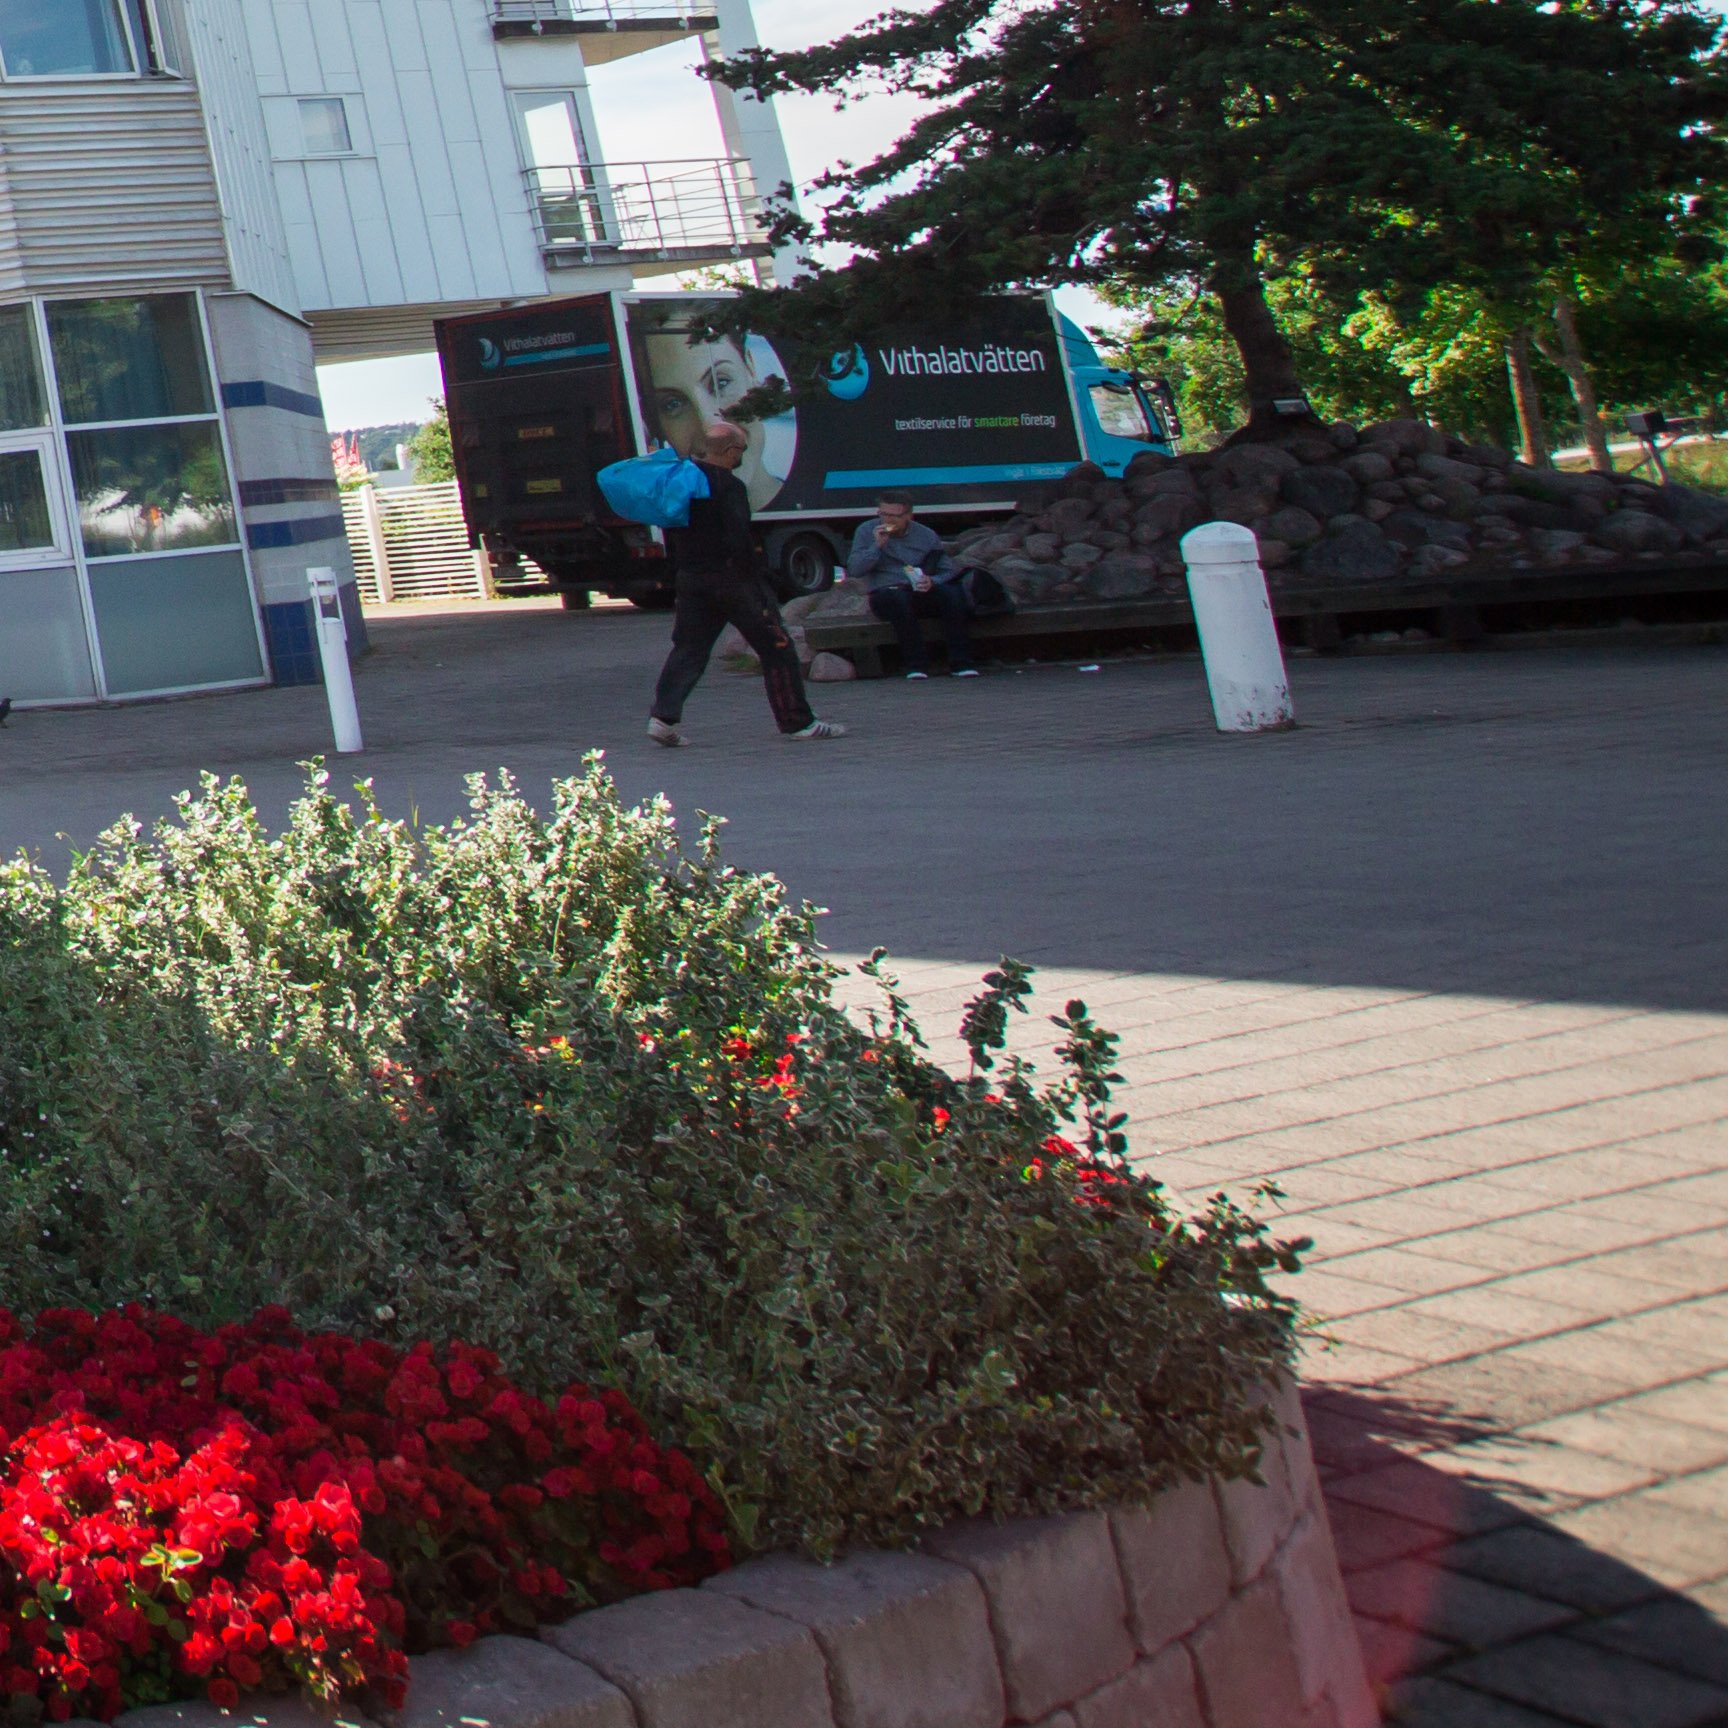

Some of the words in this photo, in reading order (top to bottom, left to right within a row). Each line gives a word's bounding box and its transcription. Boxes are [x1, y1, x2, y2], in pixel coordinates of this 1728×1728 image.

[878, 343, 1046, 376] Vithalatvätten
[894, 417, 956, 432] textilservice
[957, 415, 972, 429] för
[973, 415, 1020, 429] smartare
[1020, 413, 1056, 428] företag
